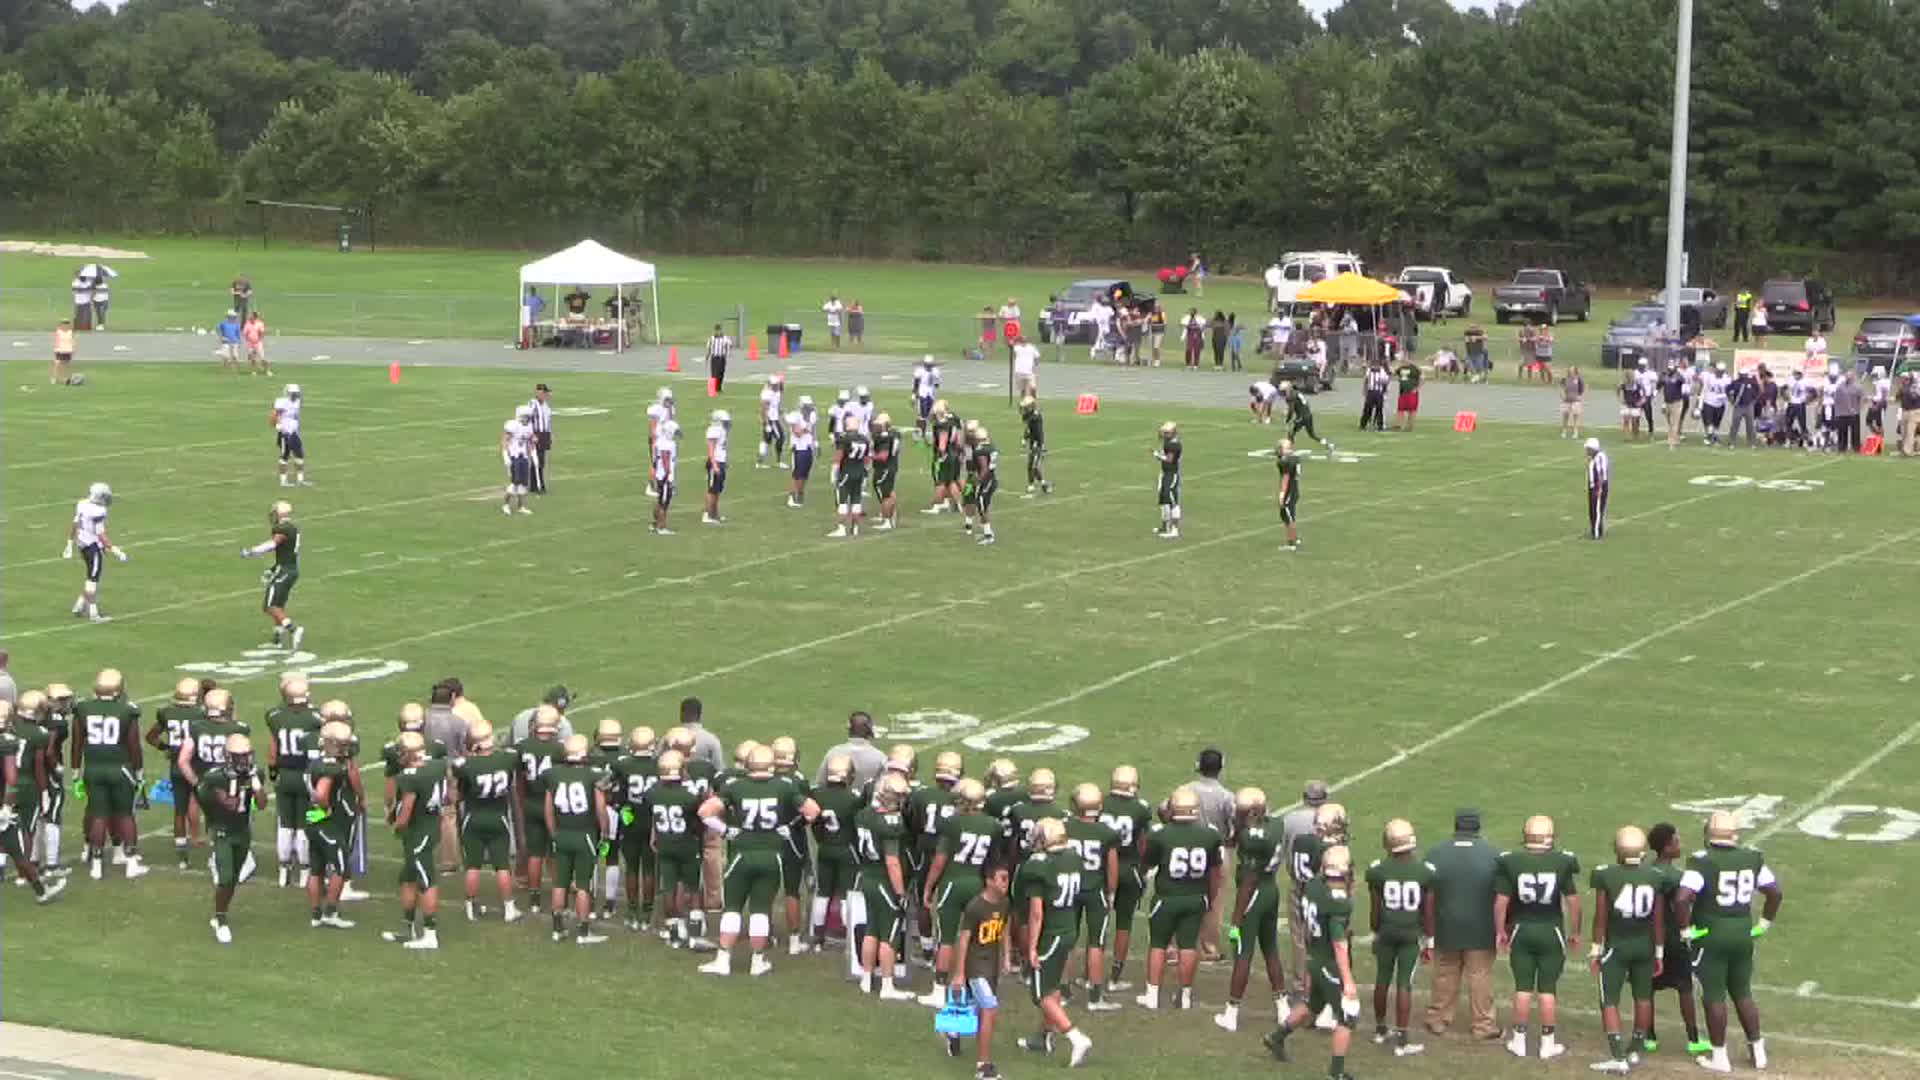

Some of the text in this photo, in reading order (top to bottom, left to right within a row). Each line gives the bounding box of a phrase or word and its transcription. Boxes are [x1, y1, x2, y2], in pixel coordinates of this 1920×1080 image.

[86, 714, 120, 745] 50
[168, 720, 190, 746] 21
[872, 708, 1090, 752] 30
[476, 770, 508, 799] 72
[554, 782, 588, 814] 48
[653, 804, 687, 832] 36
[742, 798, 779, 831] 75
[1670, 793, 1920, 841] 40
[1169, 847, 1207, 879] 69
[1383, 880, 1420, 911] 90
[1517, 872, 1556, 905] 67
[1614, 883, 1655, 918] 40
[1716, 869, 1755, 907] 58
